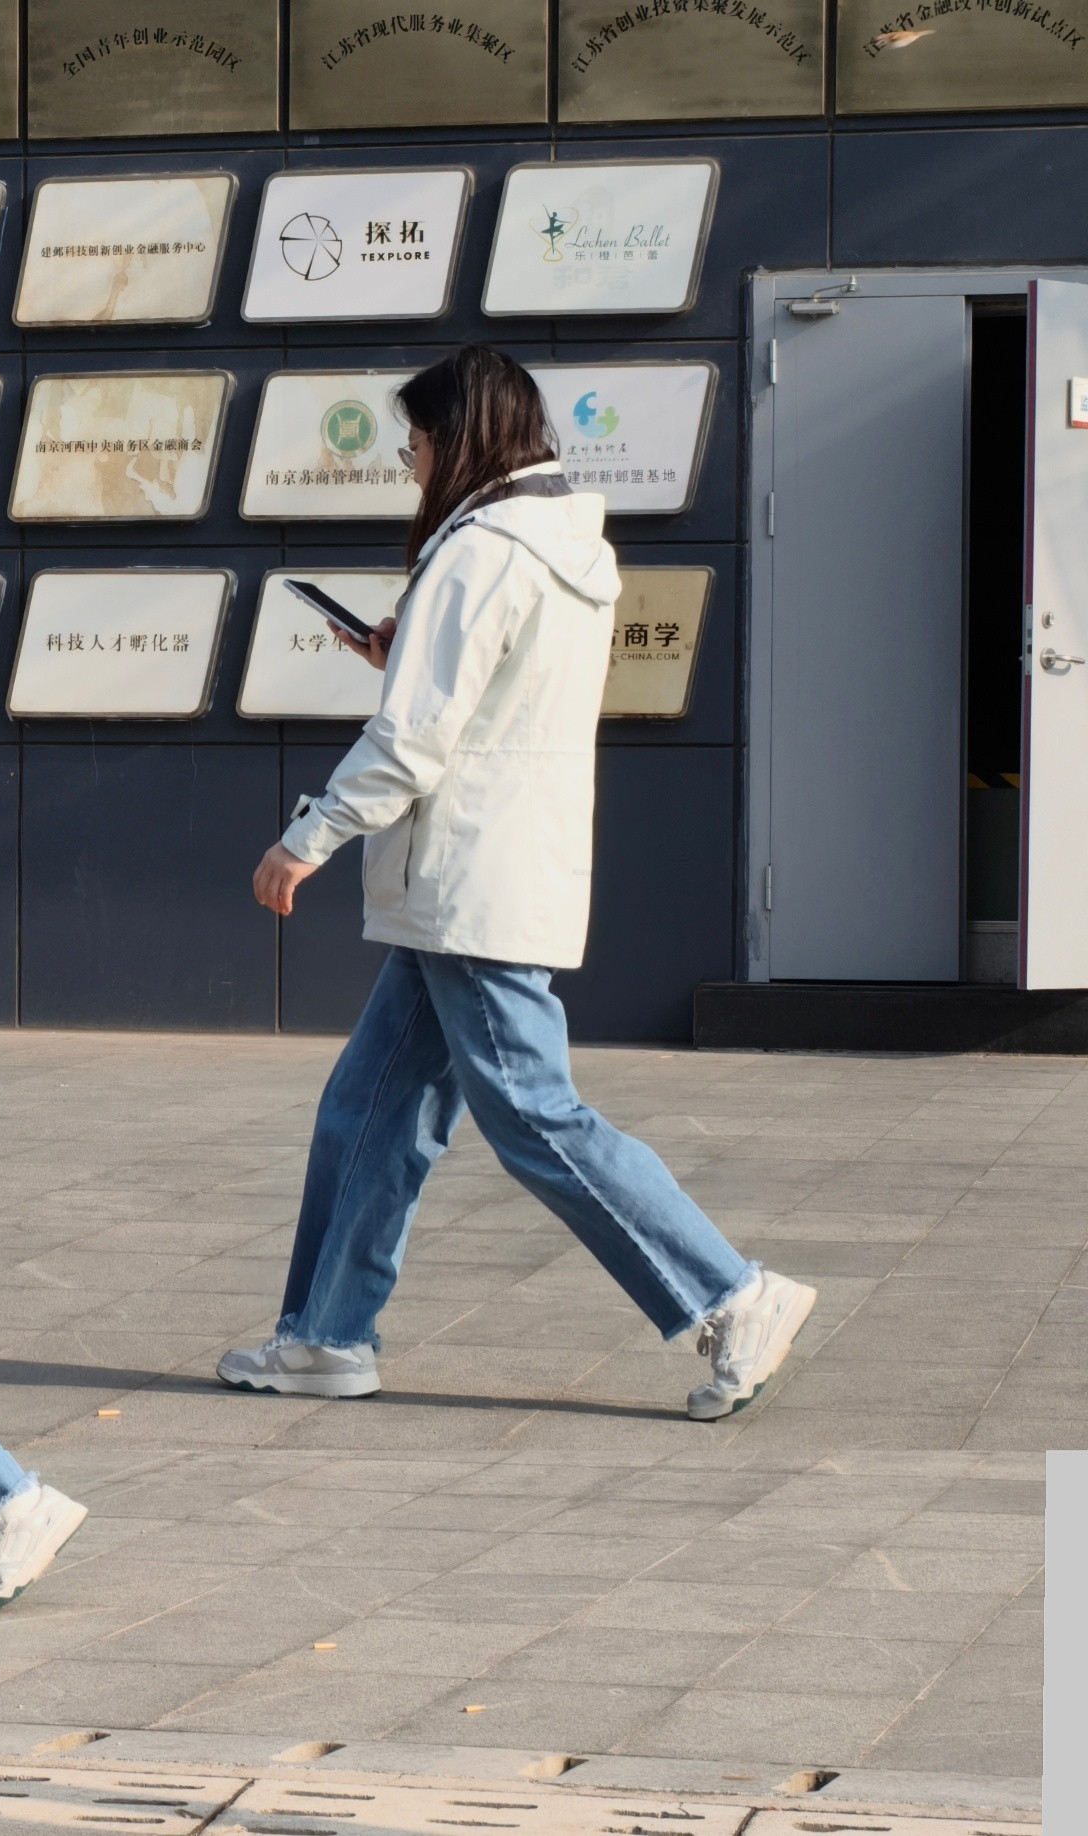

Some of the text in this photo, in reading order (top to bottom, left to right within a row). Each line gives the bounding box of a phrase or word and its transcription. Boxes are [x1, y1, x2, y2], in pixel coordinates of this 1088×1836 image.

[63, 27, 242, 80] 全国青年创业示范园区
[321, 14, 515, 70] 江苏省现代服务业集聚区
[365, 220, 426, 245] 探拓
[565, 224, 671, 248] Lechen Ballet
[361, 251, 430, 261] TEXPLORE
[35, 438, 202, 453] 南京河西中央商务区金融商会
[568, 468, 676, 485] 建邺新邺盟基地
[47, 632, 190, 652] 科技人才孵化器
[612, 623, 679, 647] 商学
